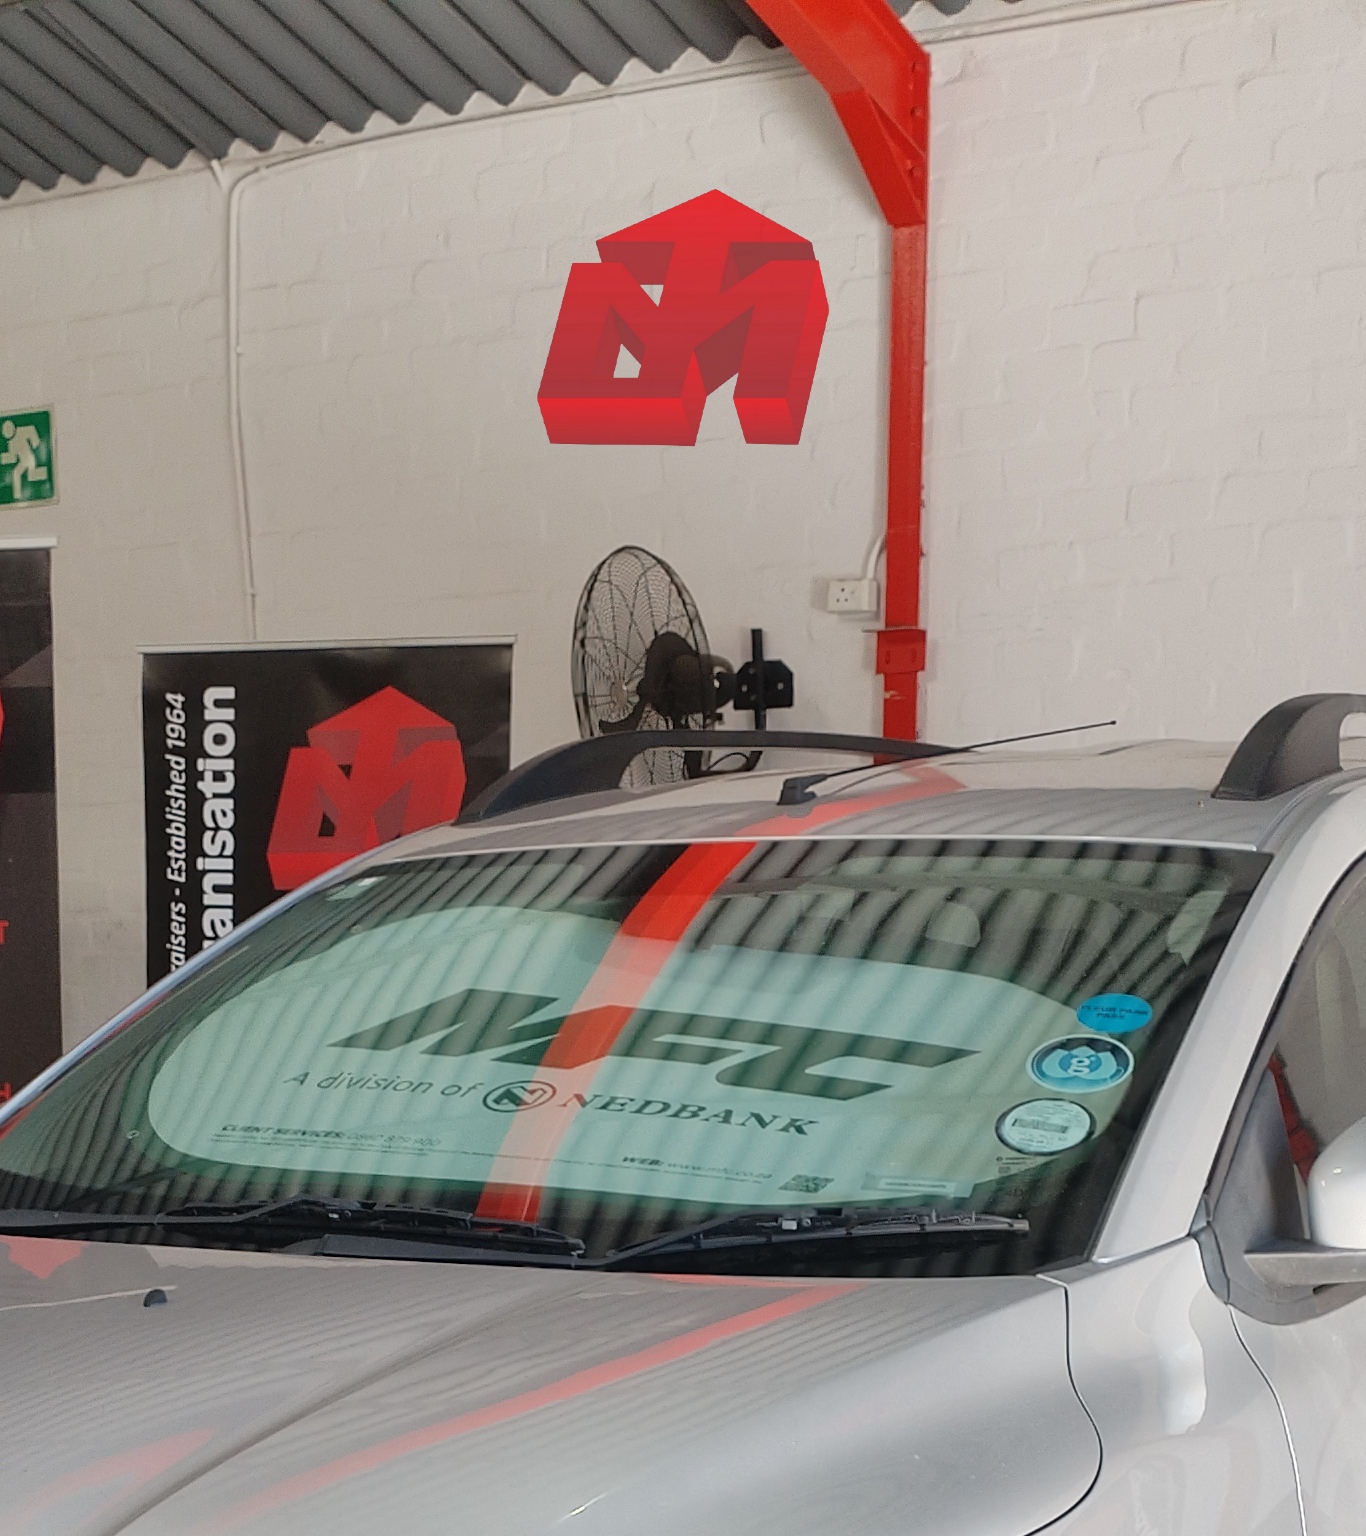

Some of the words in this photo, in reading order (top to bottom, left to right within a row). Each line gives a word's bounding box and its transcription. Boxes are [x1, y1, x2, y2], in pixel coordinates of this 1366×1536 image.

[165, 692, 186, 748] 1964
[164, 754, 186, 883] Established
[196, 686, 236, 949] anisation
[283, 1071, 310, 1087] A
[317, 1072, 433, 1096] division
[440, 1081, 487, 1099] of
[556, 1093, 819, 1136] NEDBANK
